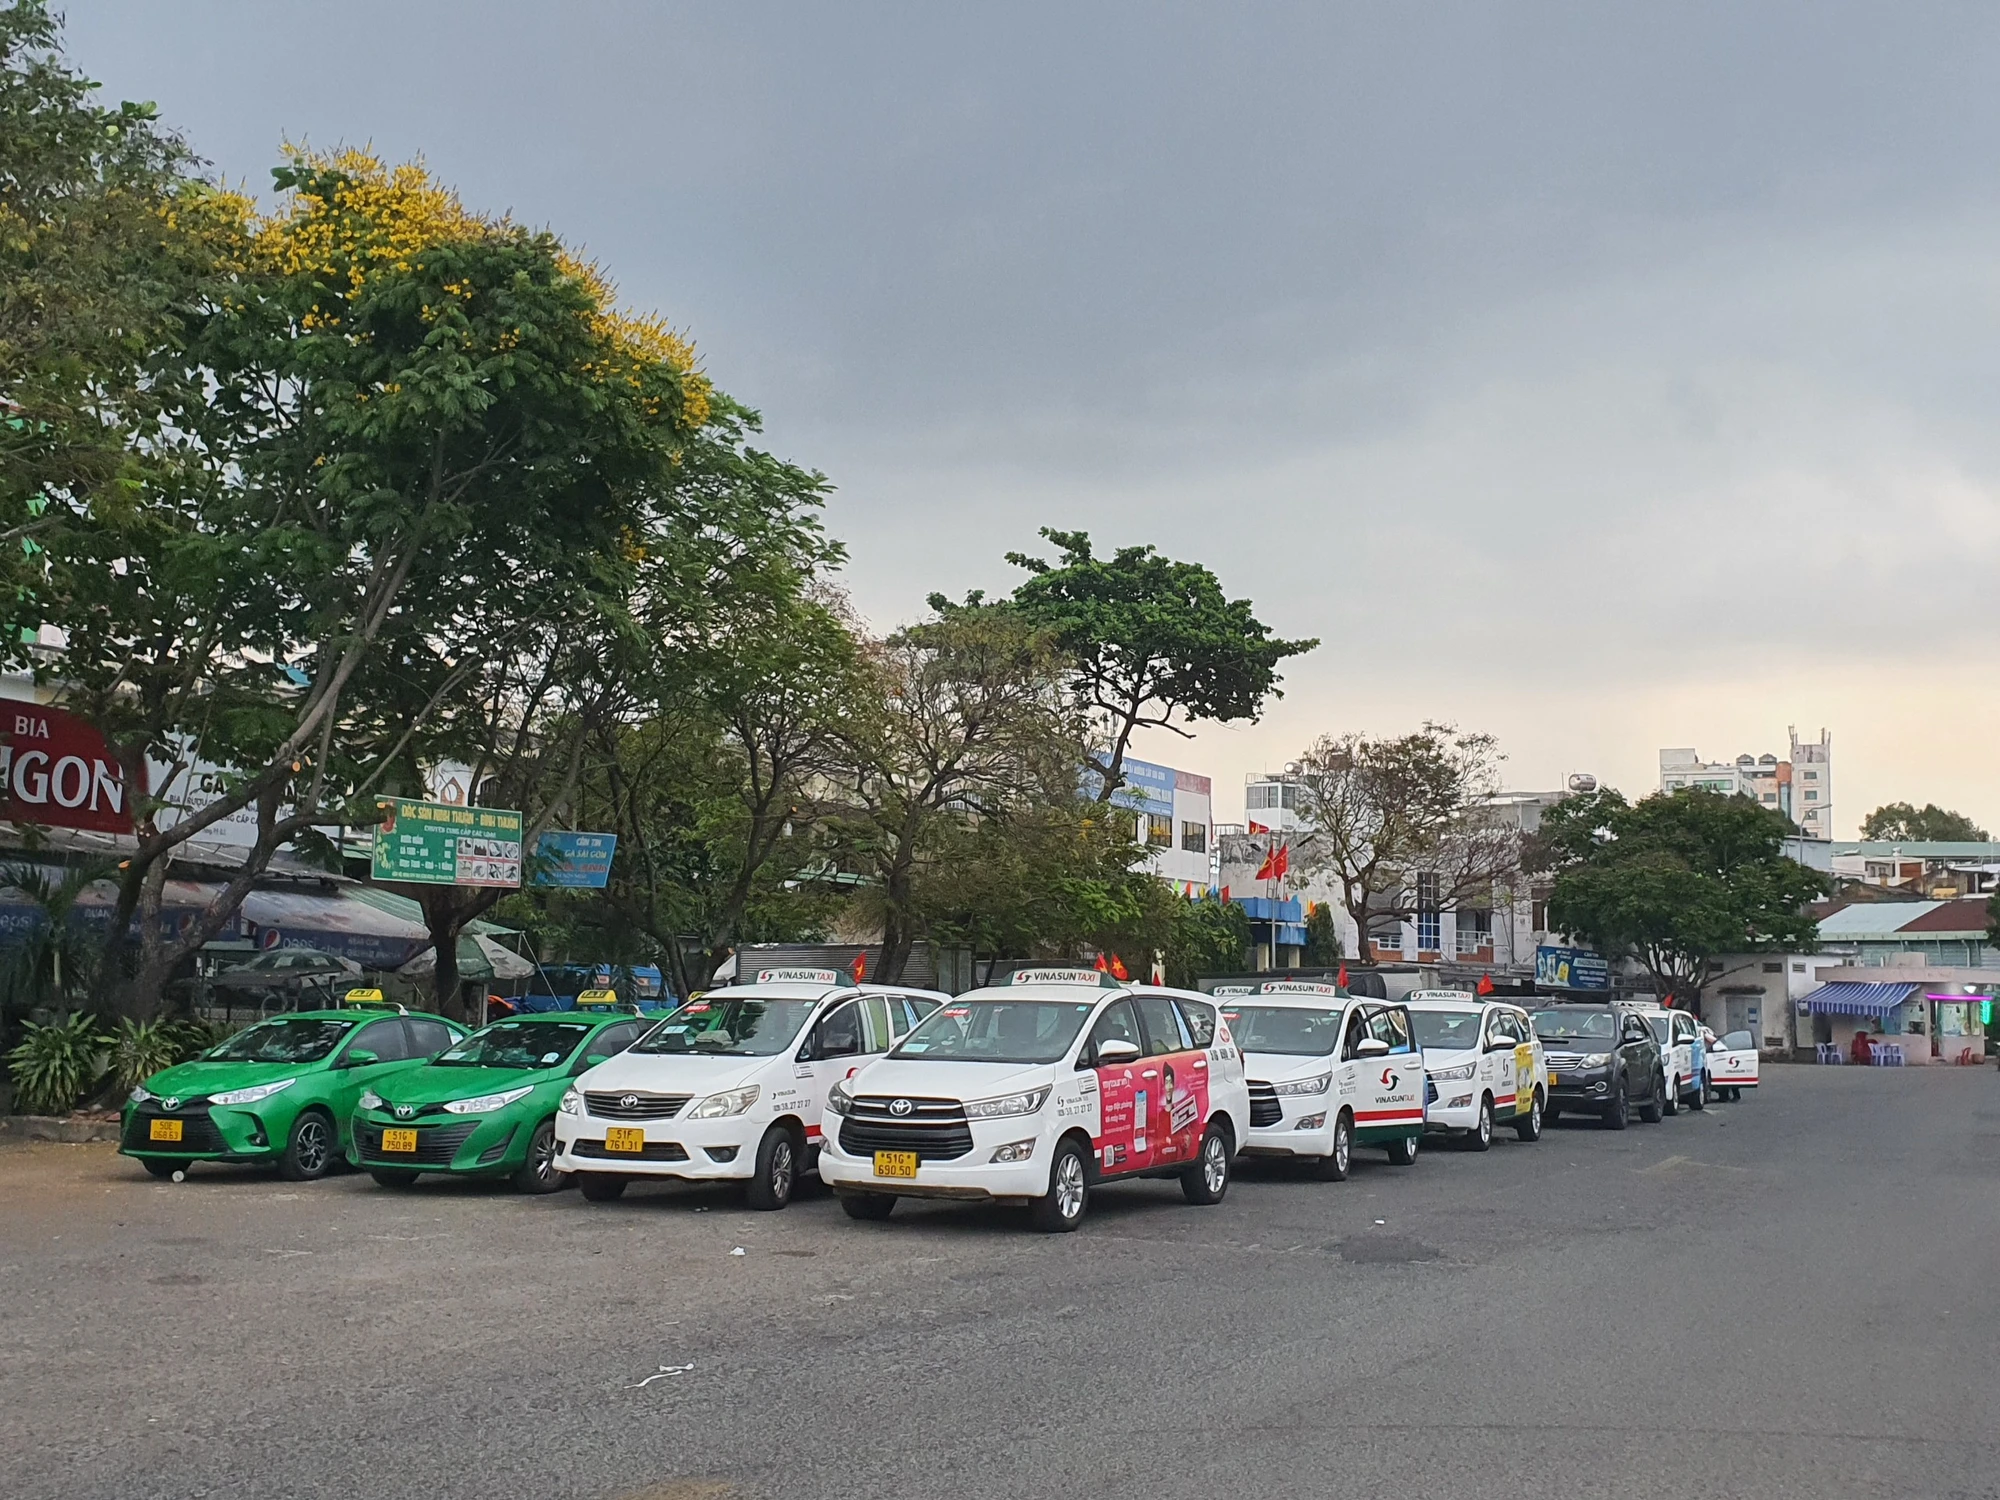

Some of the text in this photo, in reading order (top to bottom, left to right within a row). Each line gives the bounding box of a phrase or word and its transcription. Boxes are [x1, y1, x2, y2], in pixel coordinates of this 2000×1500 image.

[15, 715, 49, 739] BIA
[0, 745, 124, 814] IGON
[392, 1130, 408, 1141] 51G
[616, 1129, 633, 1140] 51F
[385, 1140, 413, 1151] 750.89
[609, 1139, 638, 1151] 761.31
[886, 1153, 905, 1165] 51G
[878, 1164, 911, 1176] 690.50
